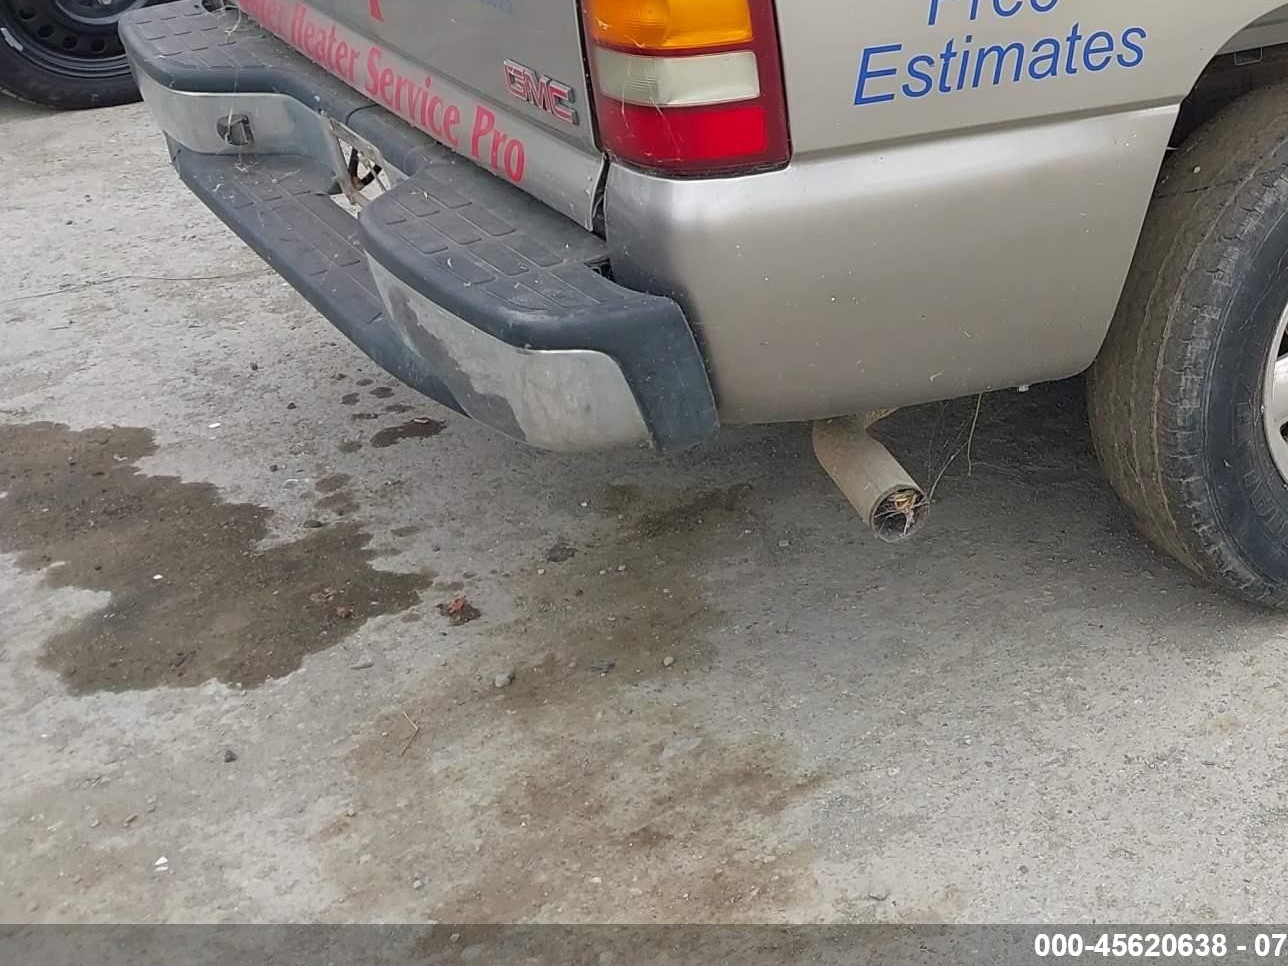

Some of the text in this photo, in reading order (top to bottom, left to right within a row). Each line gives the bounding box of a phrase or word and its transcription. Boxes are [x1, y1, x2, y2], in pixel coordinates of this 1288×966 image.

[291, 1, 361, 82] Heater
[366, 47, 461, 148] Service
[471, 104, 525, 183] Pro
[503, 58, 579, 126] GMC
[854, 22, 1146, 105] Estimates
